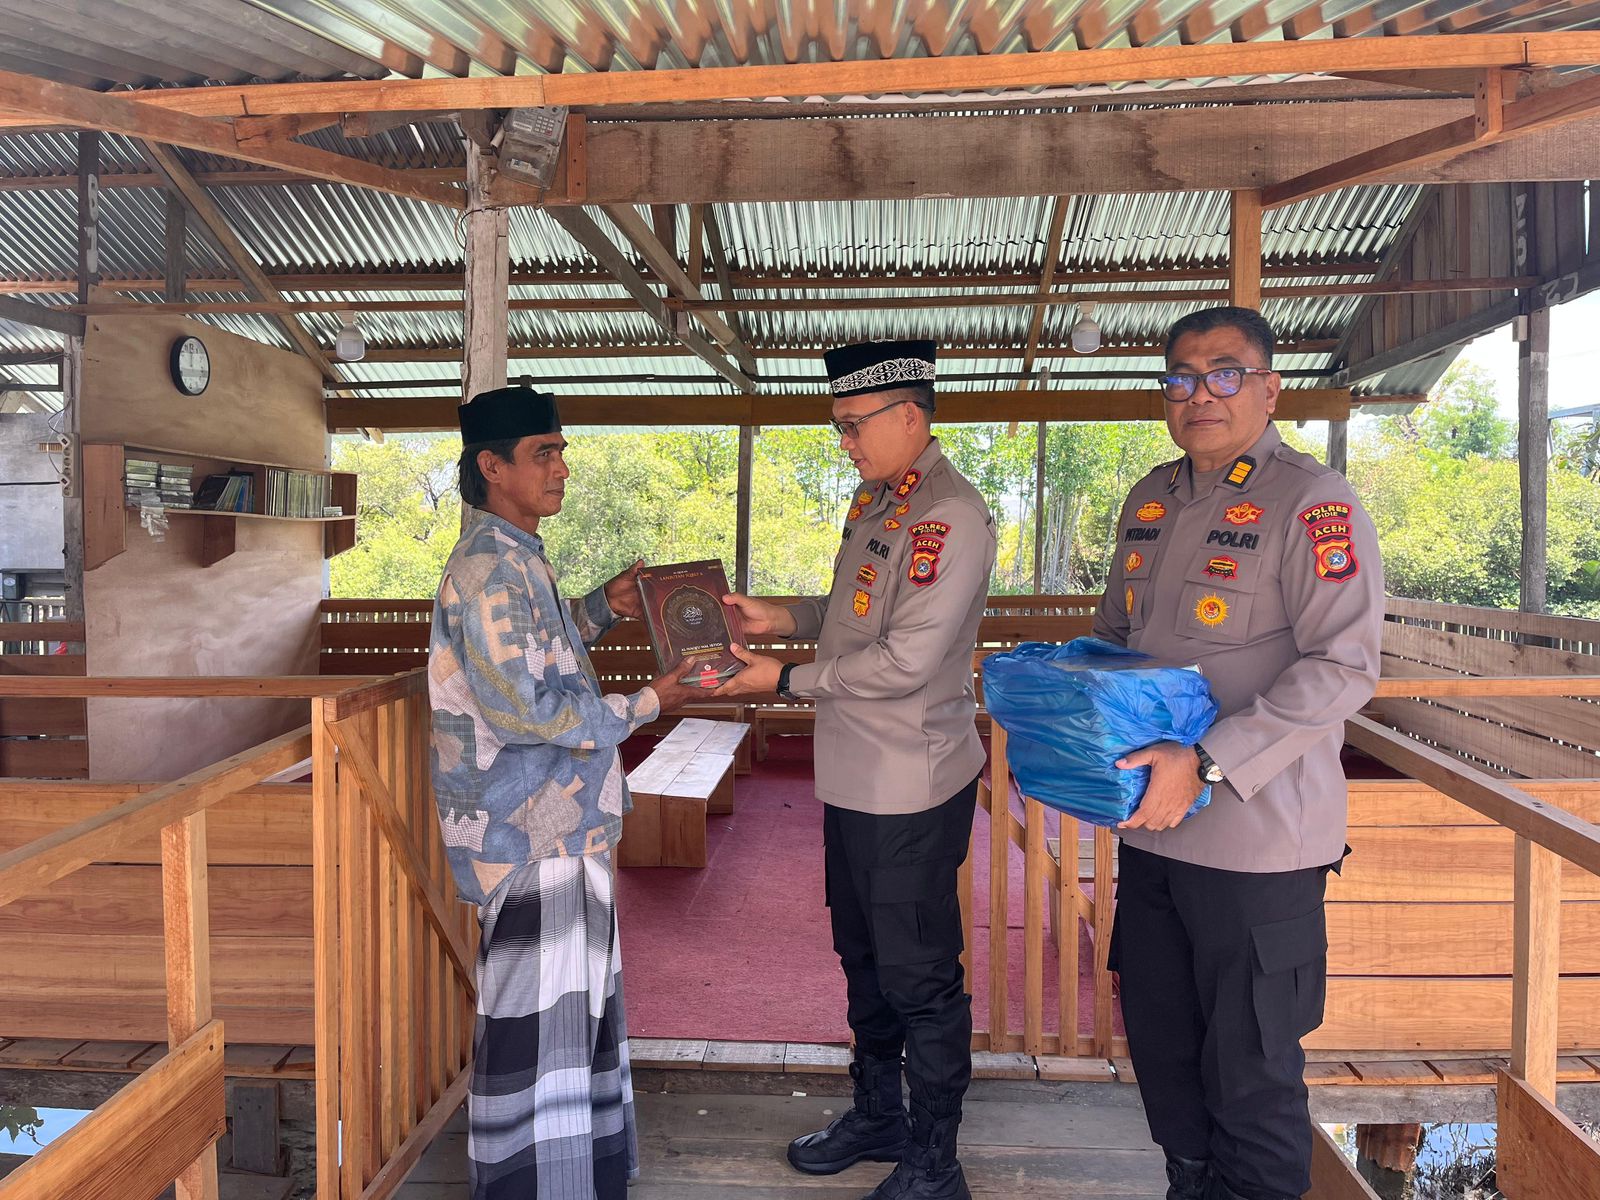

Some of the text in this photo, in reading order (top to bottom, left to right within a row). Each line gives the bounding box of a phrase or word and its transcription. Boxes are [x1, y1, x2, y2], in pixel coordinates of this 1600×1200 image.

[1304, 505, 1349, 521] POLRES
[1316, 511, 1338, 520] PIDIE
[912, 523, 947, 534] POLRES
[1315, 525, 1346, 538] ACEH
[916, 539, 940, 549] ACEH
[1206, 529, 1260, 550] POLRI
[865, 538, 891, 560] POLRI
